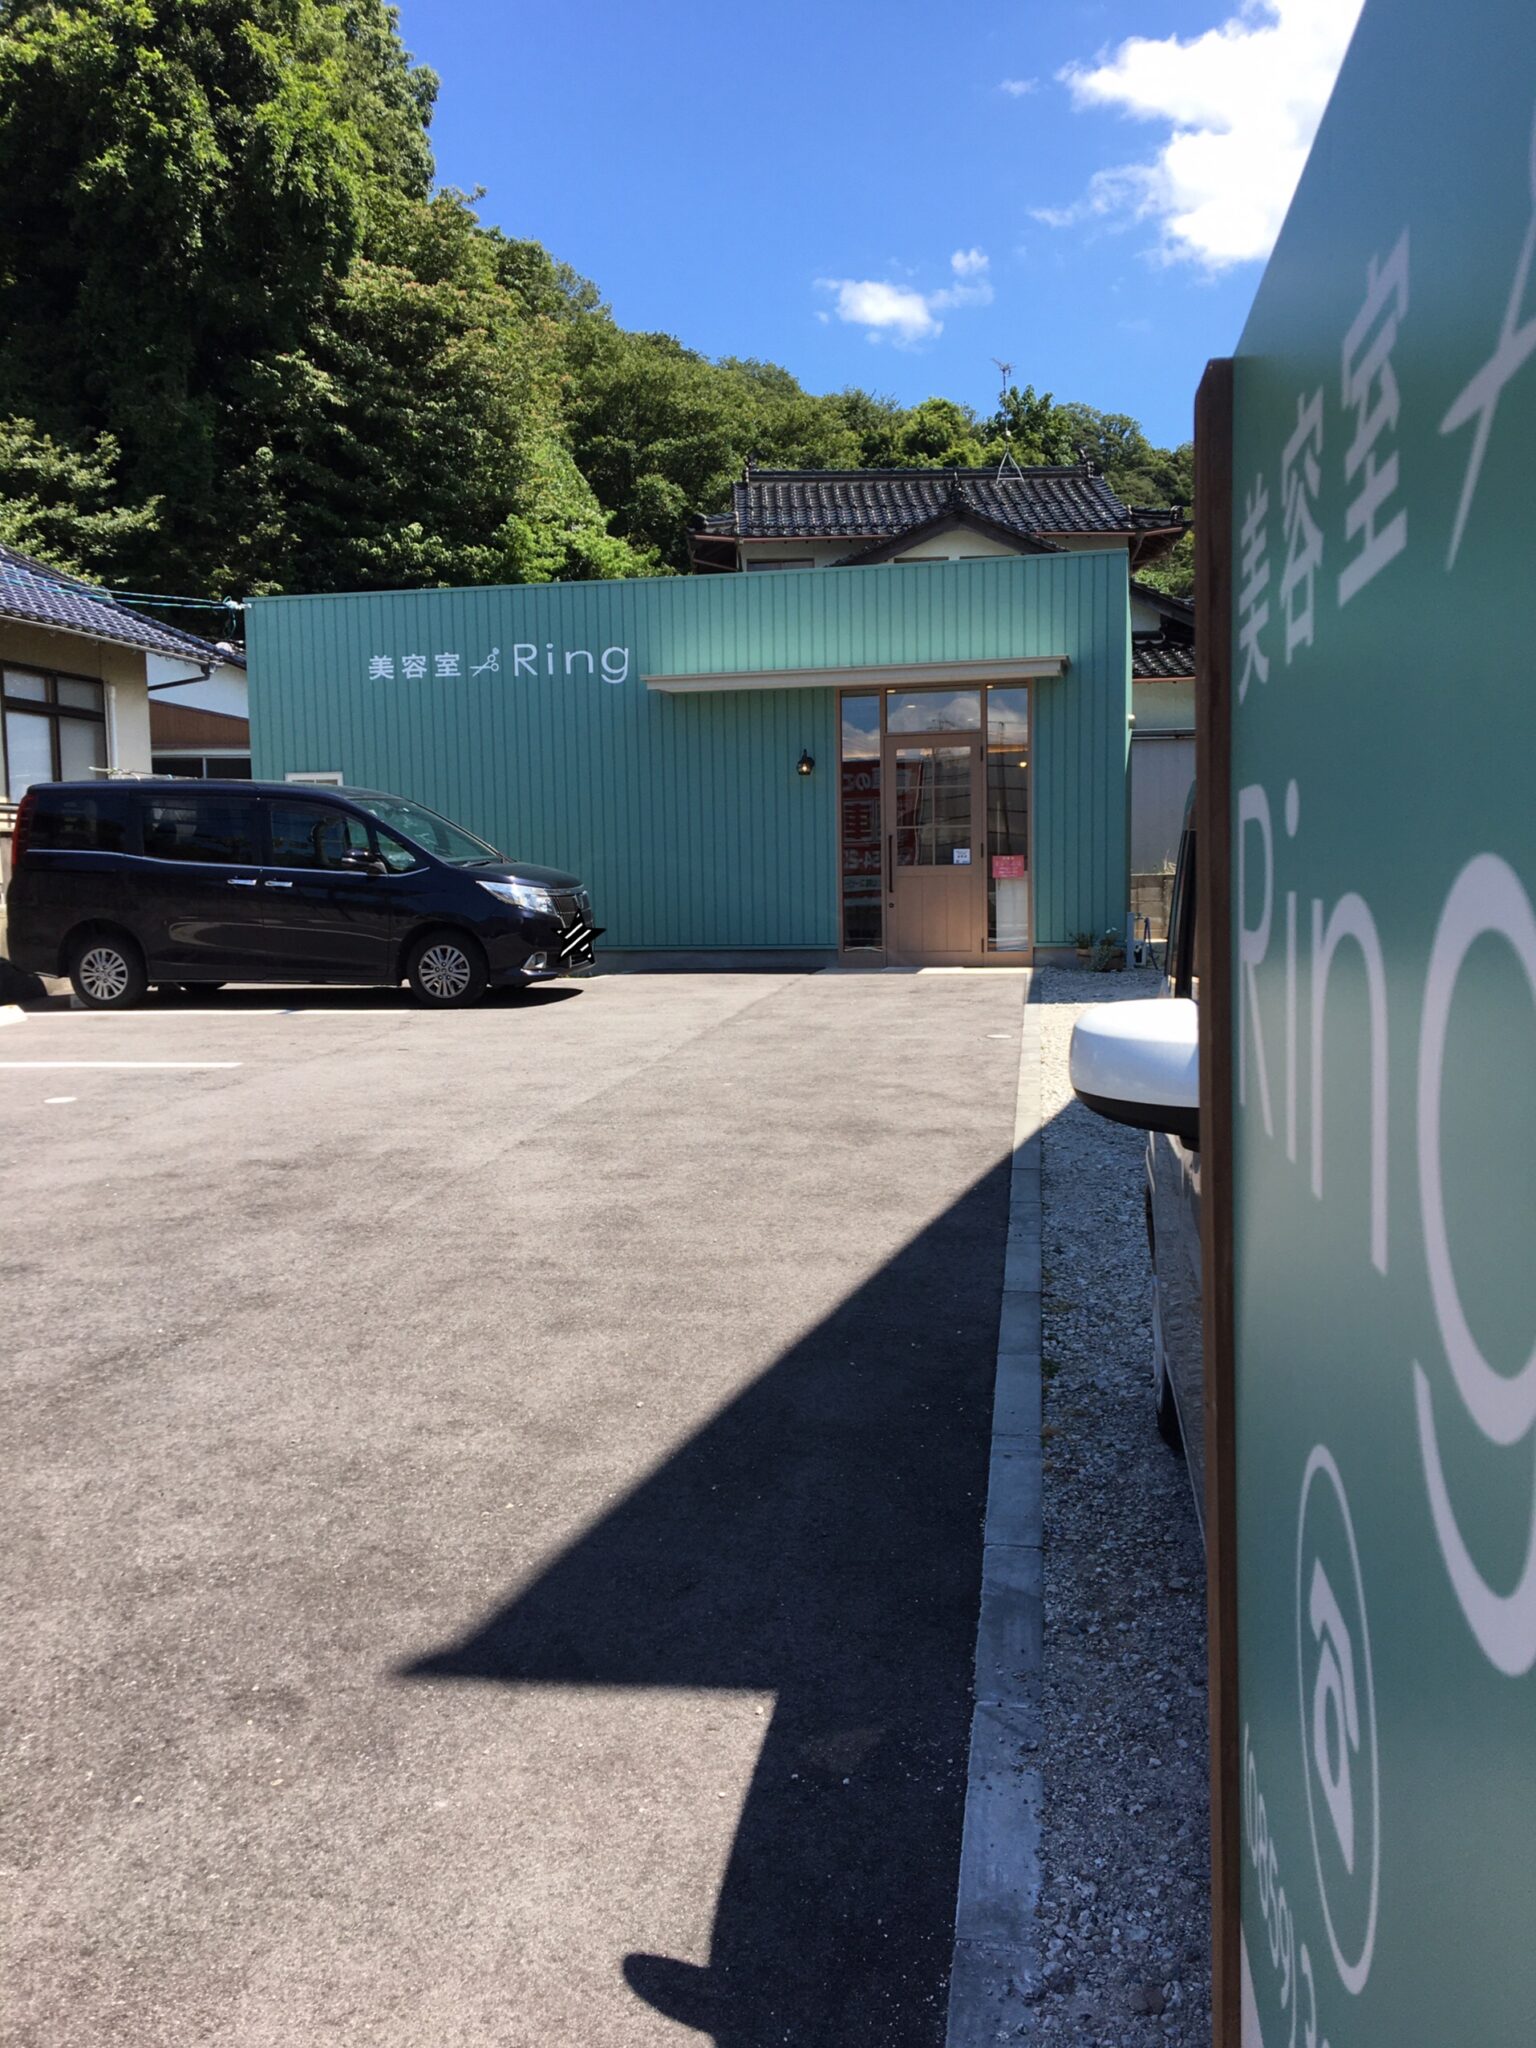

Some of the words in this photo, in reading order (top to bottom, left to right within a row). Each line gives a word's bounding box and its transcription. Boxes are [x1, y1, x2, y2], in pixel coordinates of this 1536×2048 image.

[368, 652, 461, 680] 美容室
[513, 643, 629, 684] Ring
[1239, 225, 1408, 702] 美容室
[1238, 778, 1536, 1676] Ring
